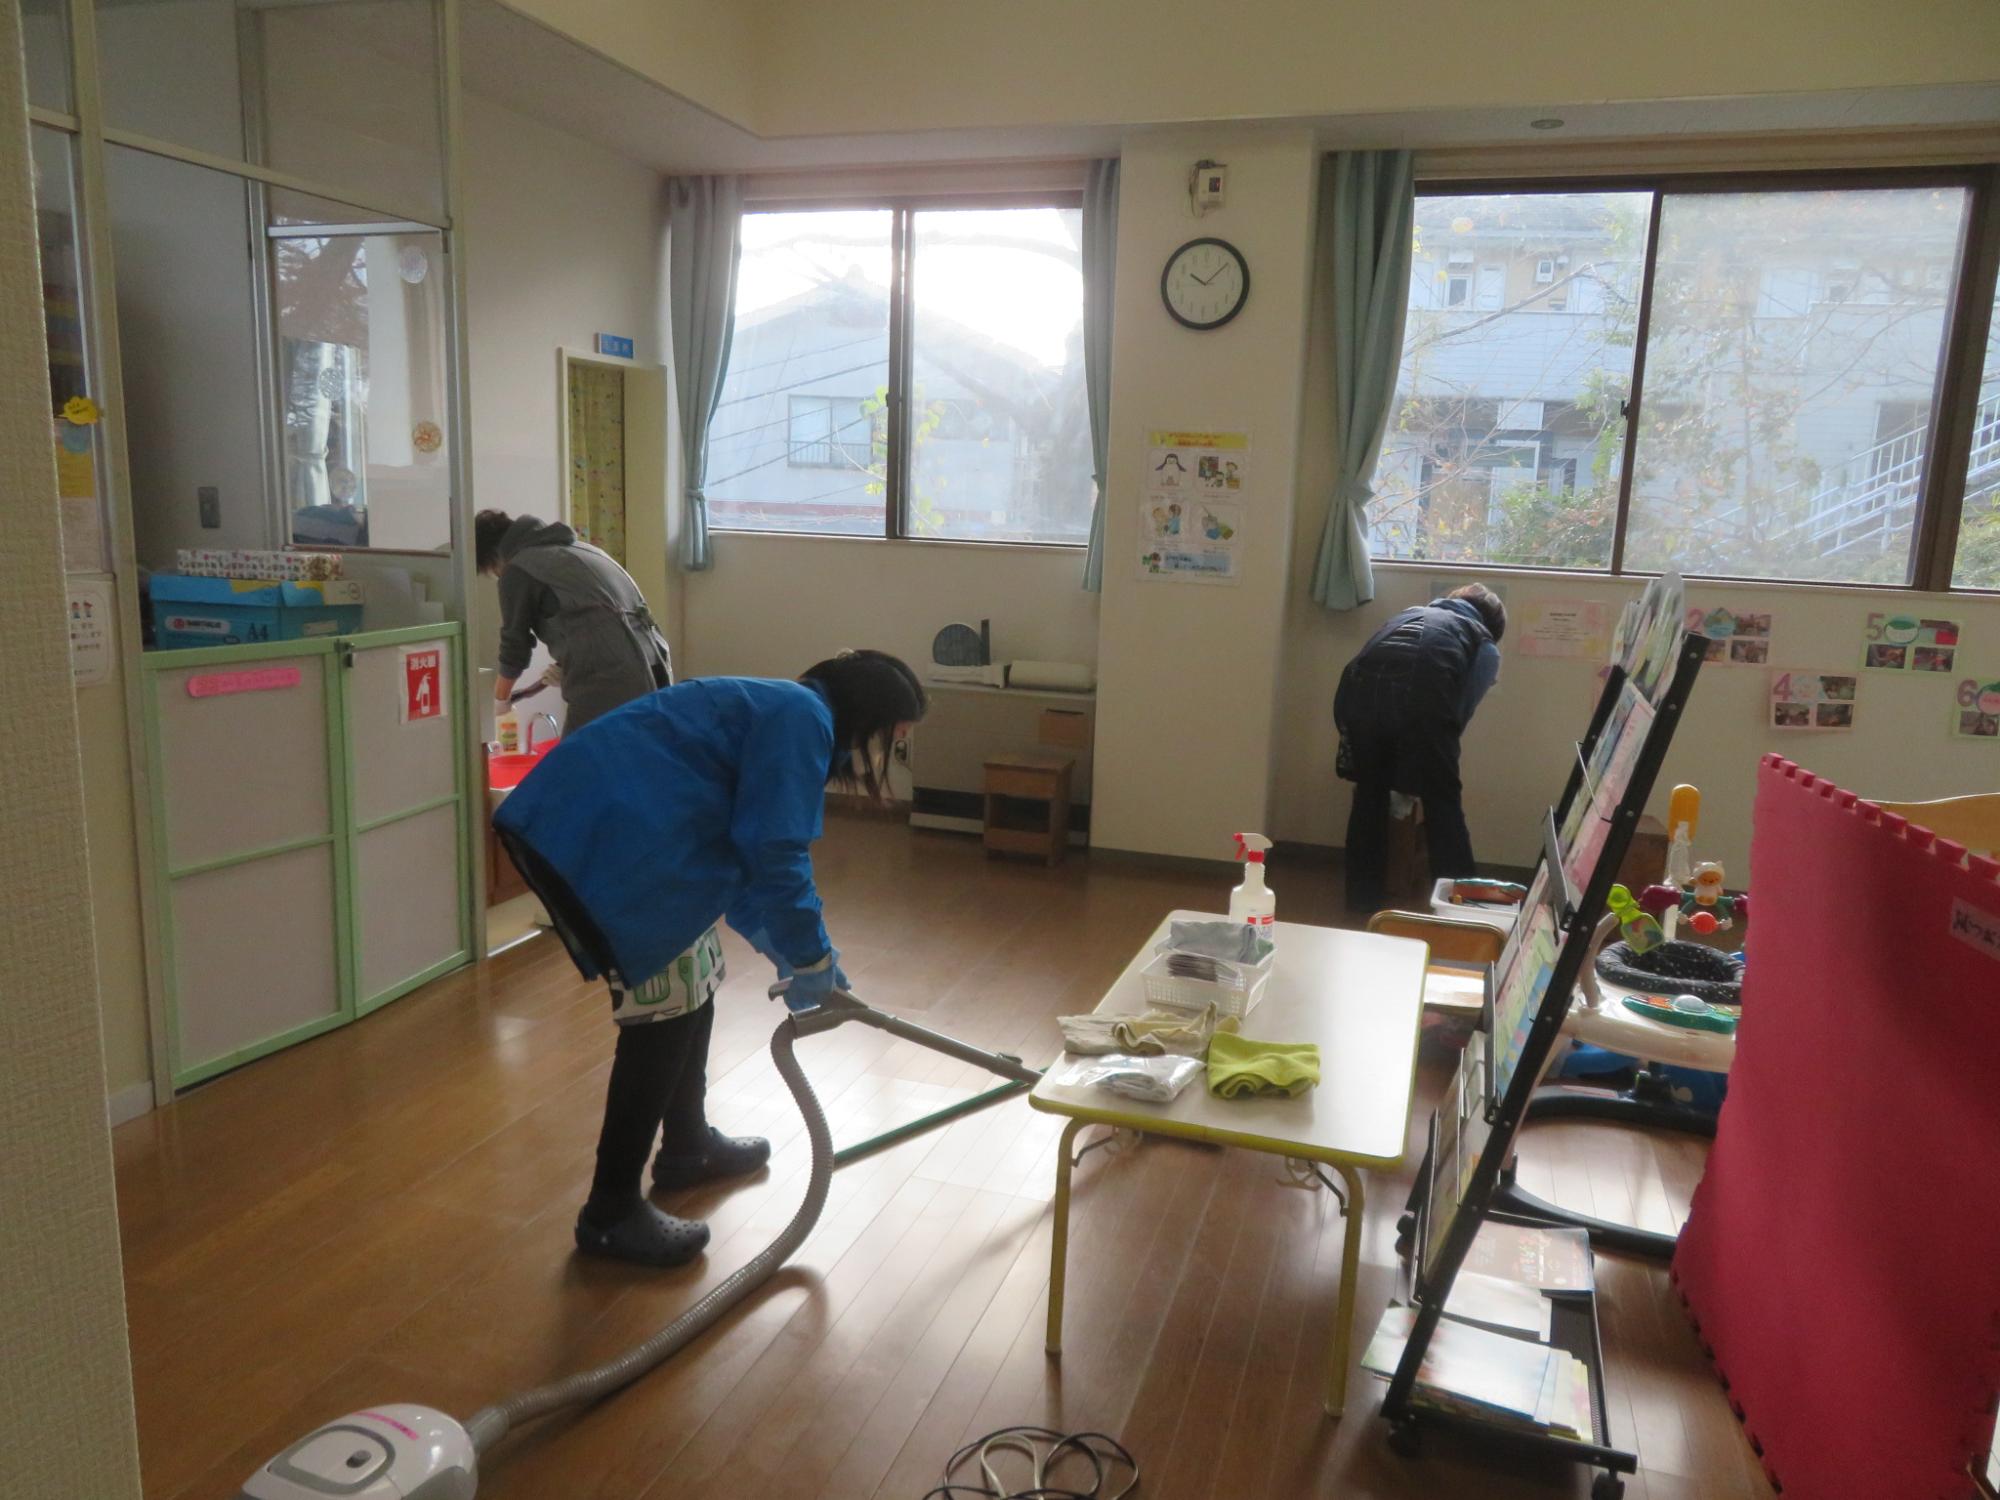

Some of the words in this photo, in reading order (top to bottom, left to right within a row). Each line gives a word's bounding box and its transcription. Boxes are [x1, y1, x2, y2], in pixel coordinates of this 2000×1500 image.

[247, 622, 269, 641] A4
[1866, 612, 1885, 641] 5
[1773, 672, 1792, 701] 4
[1957, 679, 1977, 707] 6
